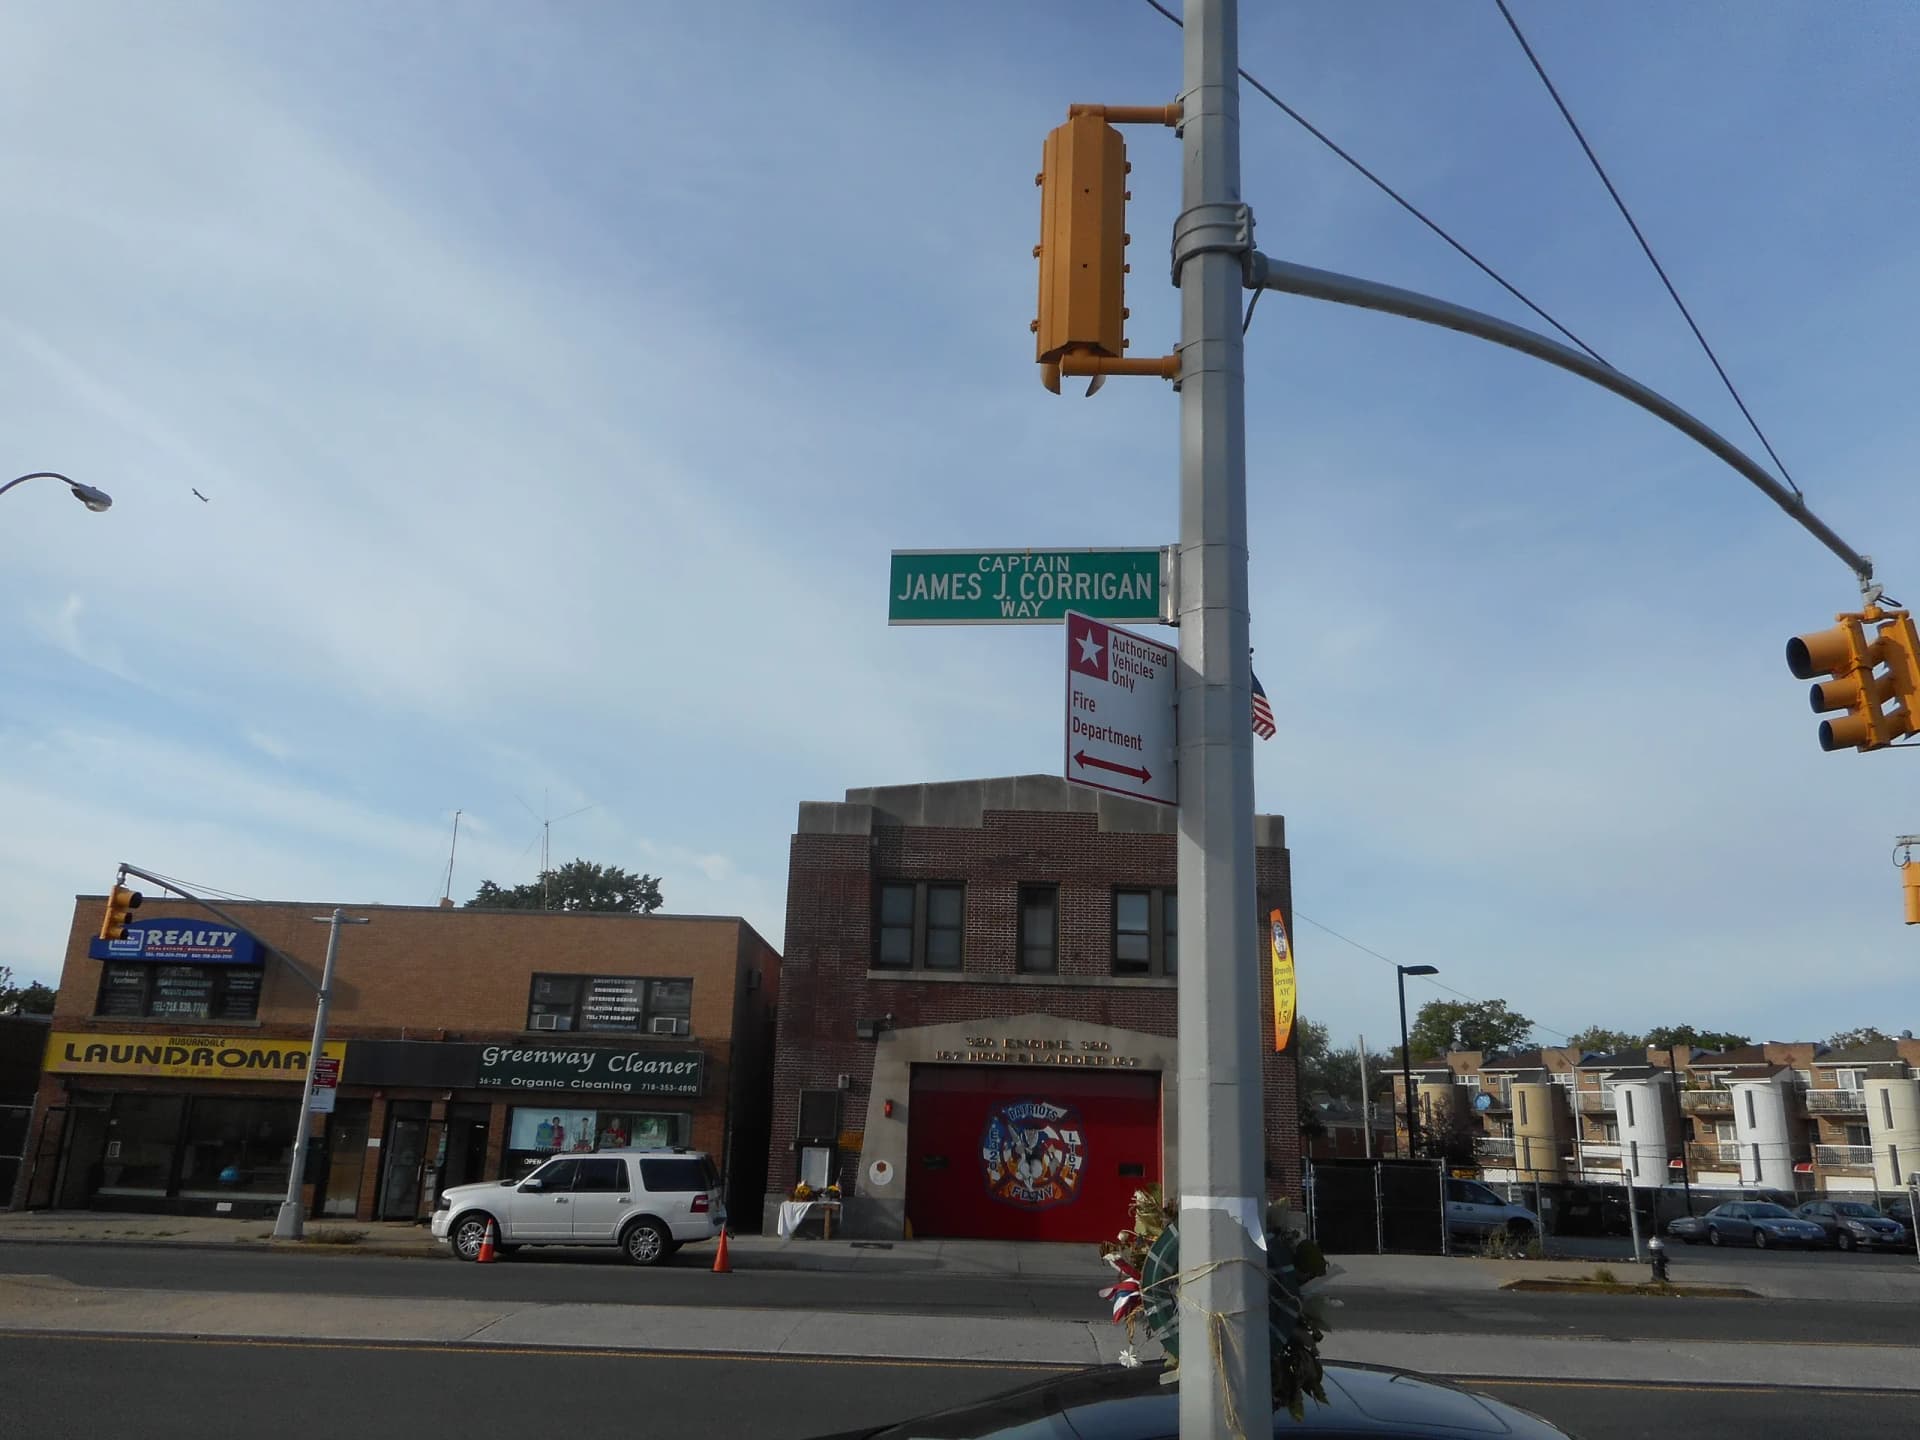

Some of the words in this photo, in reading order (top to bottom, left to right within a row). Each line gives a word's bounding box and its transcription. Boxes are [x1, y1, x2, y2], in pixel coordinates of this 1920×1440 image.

[978, 556, 1070, 572] CAPTAIN
[898, 573, 982, 600] JAMES
[993, 573, 1012, 601] J.
[1019, 572, 1152, 601] CORRIGAN
[1000, 601, 1044, 617] WAY
[1112, 635, 1168, 668] Authorized
[1112, 653, 1154, 680] Vehicles
[1112, 670, 1135, 693] Only
[1073, 691, 1096, 713] Fire
[1073, 719, 1143, 751] Department
[147, 930, 237, 947] REALTY
[1003, 1038, 1073, 1051] ENGINE
[1081, 1041, 1113, 1052] 320
[481, 1046, 597, 1073] Greenway
[607, 1052, 698, 1075] Cleaner
[1031, 1052, 1105, 1065] LADDER
[479, 1077, 502, 1085] 36-22
[511, 1077, 565, 1089] Organic
[571, 1079, 632, 1092] Cleaning
[1008, 1104, 1058, 1121] PATRIOTS
[1012, 1185, 1053, 1201] FDNY
